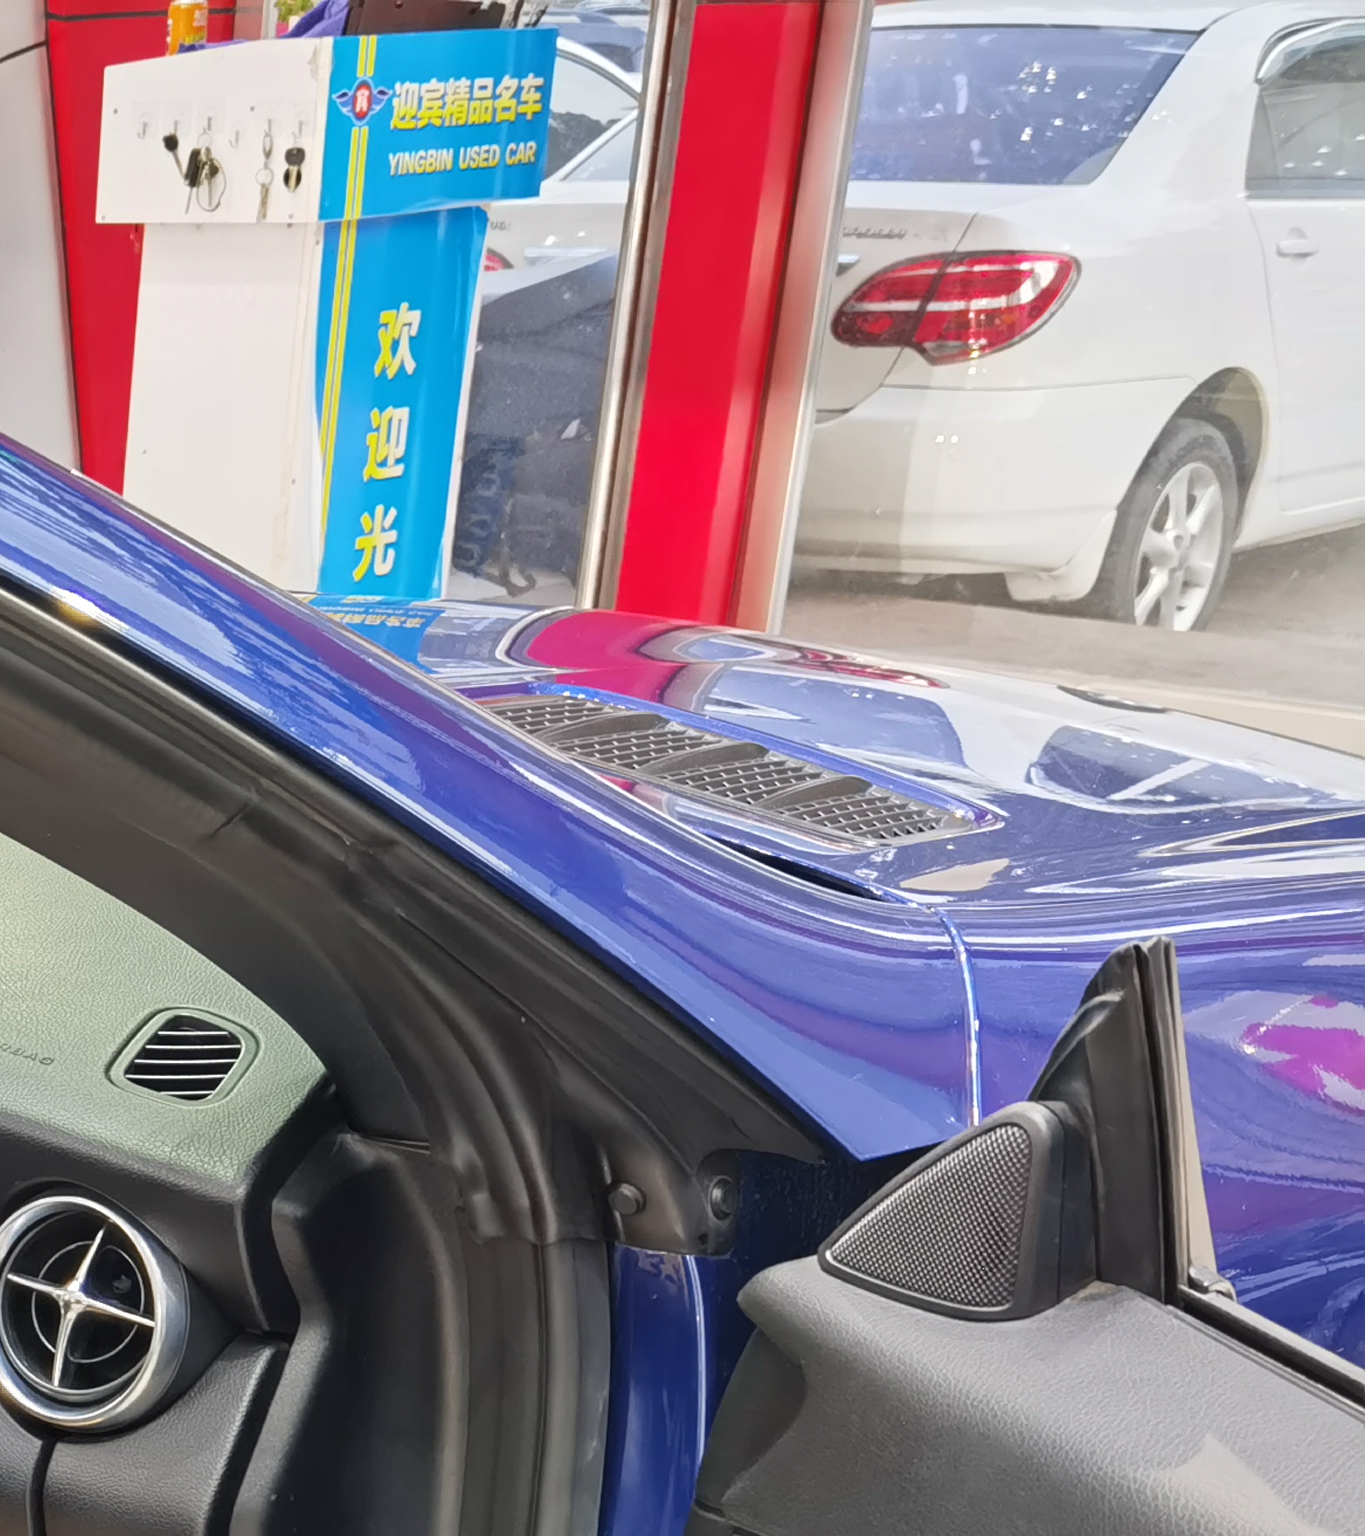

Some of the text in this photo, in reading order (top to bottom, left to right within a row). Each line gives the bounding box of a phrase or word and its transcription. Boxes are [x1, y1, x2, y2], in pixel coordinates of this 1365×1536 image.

[390, 73, 545, 131] 迎宾精品名车
[388, 140, 538, 177] YINGBIN USED CAR
